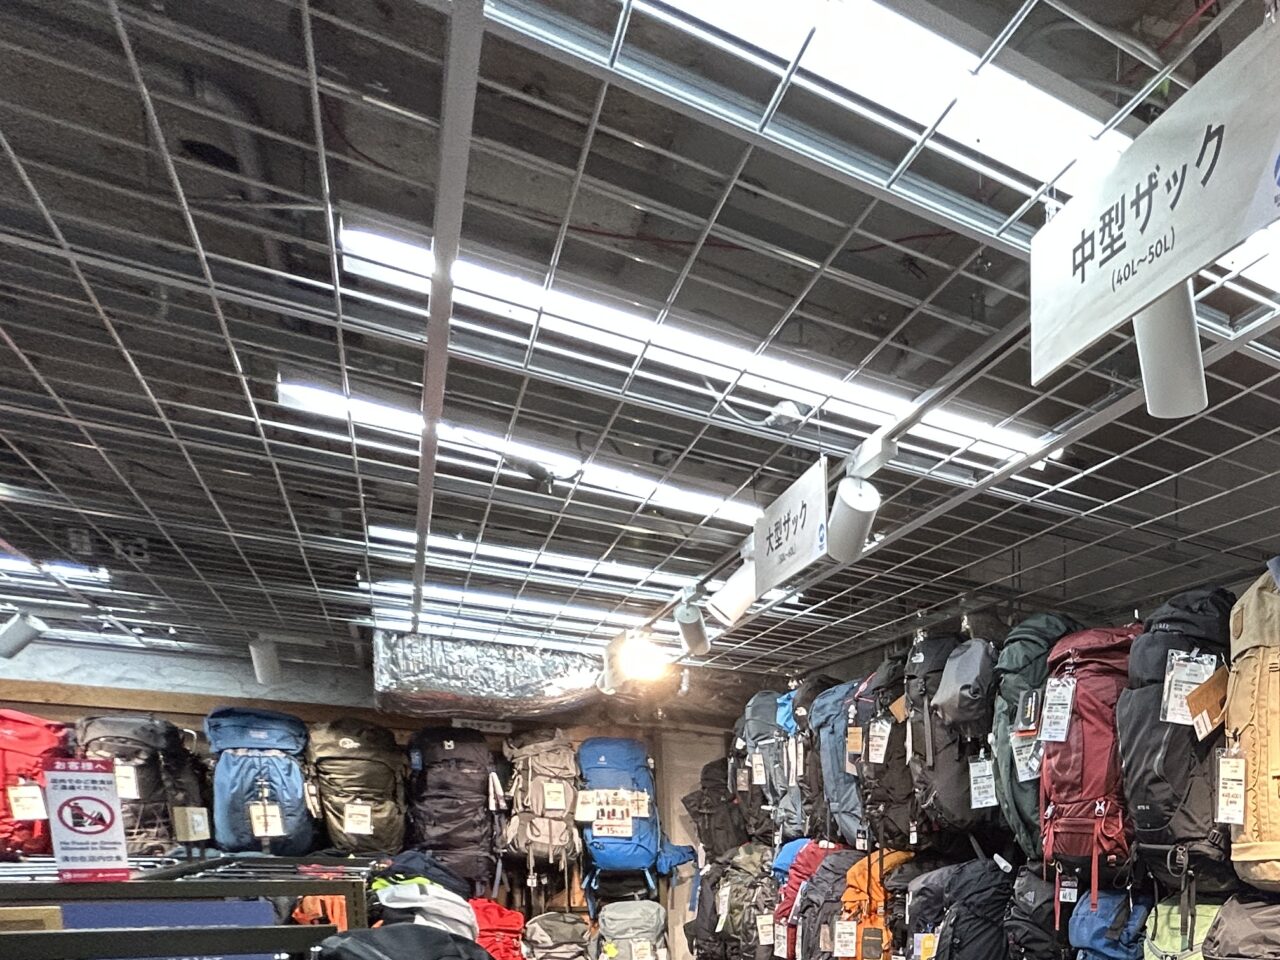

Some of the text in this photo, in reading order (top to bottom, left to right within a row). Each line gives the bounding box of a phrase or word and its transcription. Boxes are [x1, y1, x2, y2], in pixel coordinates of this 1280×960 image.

[1072, 124, 1225, 284] 中型ザック
